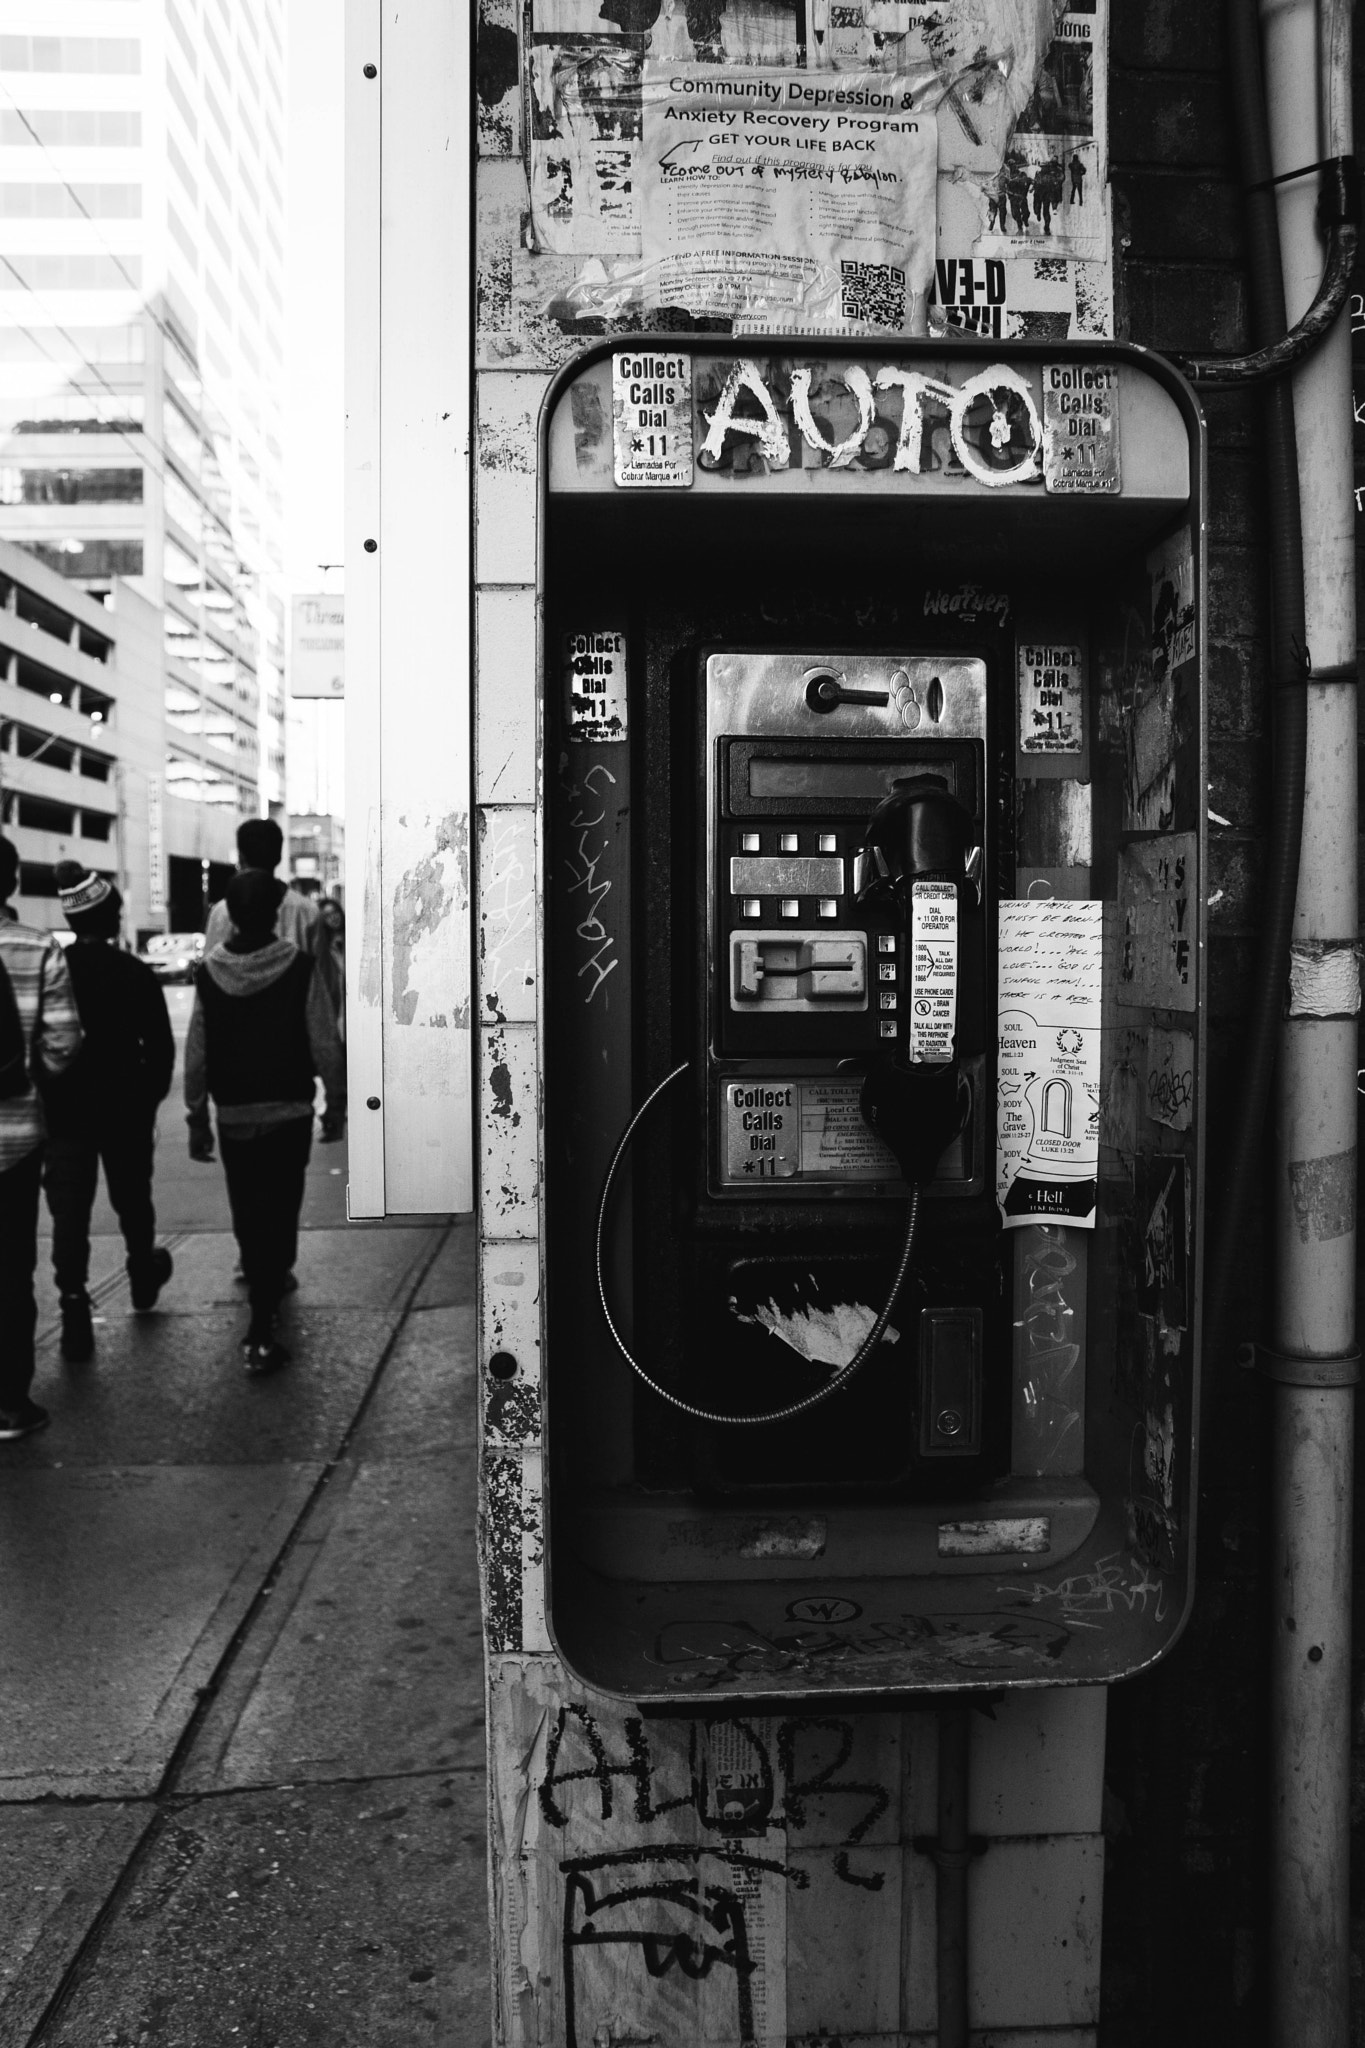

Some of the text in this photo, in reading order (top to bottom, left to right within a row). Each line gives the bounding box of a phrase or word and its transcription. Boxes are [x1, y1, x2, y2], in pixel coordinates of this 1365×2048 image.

[669, 77, 914, 110] Community Depression &
[664, 106, 919, 133] Anxiety Recovery Program
[709, 133, 876, 152] GET YOUR LIFE BACK
[712, 154, 873, 172] Find out if this program is for you
[660, 176, 684, 184] LEARN
[722, 250, 781, 260] INFORMATION
[619, 356, 685, 379] Collect
[1050, 367, 1112, 389] Collect
[629, 383, 675, 405] Calls
[1060, 392, 1103, 414] Calls
[638, 409, 667, 427] Dial
[700, 358, 1043, 487] AUTO
[1068, 418, 1096, 436] Dial
[664, 460, 677, 469] Por
[621, 472, 671, 482] Cobrar Marque
[1053, 478, 1100, 489] Cobrar Marque
[567, 635, 620, 654] Collect
[1025, 648, 1077, 667] Collect
[582, 678, 606, 693] Dial
[1033, 669, 1069, 688] Calls
[1040, 690, 1062, 706] Dial
[915, 884, 954, 892] CALL COLLECT
[1041, 914, 1061, 922] BE
[884, 943, 889, 951] 1
[939, 988, 954, 996] CARDS
[925, 1022, 933, 1030] ALL
[934, 1022, 942, 1030] DAY
[942, 1022, 953, 1030] WITH
[1004, 1024, 1023, 1032] SOUL
[927, 1031, 949, 1039] PAYPHONE
[998, 1036, 1037, 1049] Heaven
[1001, 1068, 1020, 1076] SOUL
[733, 1088, 792, 1108] Collect
[742, 1111, 783, 1131] Calls
[1006, 1112, 1022, 1121] The
[1002, 1122, 1026, 1131] Grave
[749, 1134, 776, 1151] Dial
[1062, 1140, 1081, 1148] DOOR
[1004, 1150, 1021, 1158] BODY
[1037, 1190, 1063, 1203] Hell
